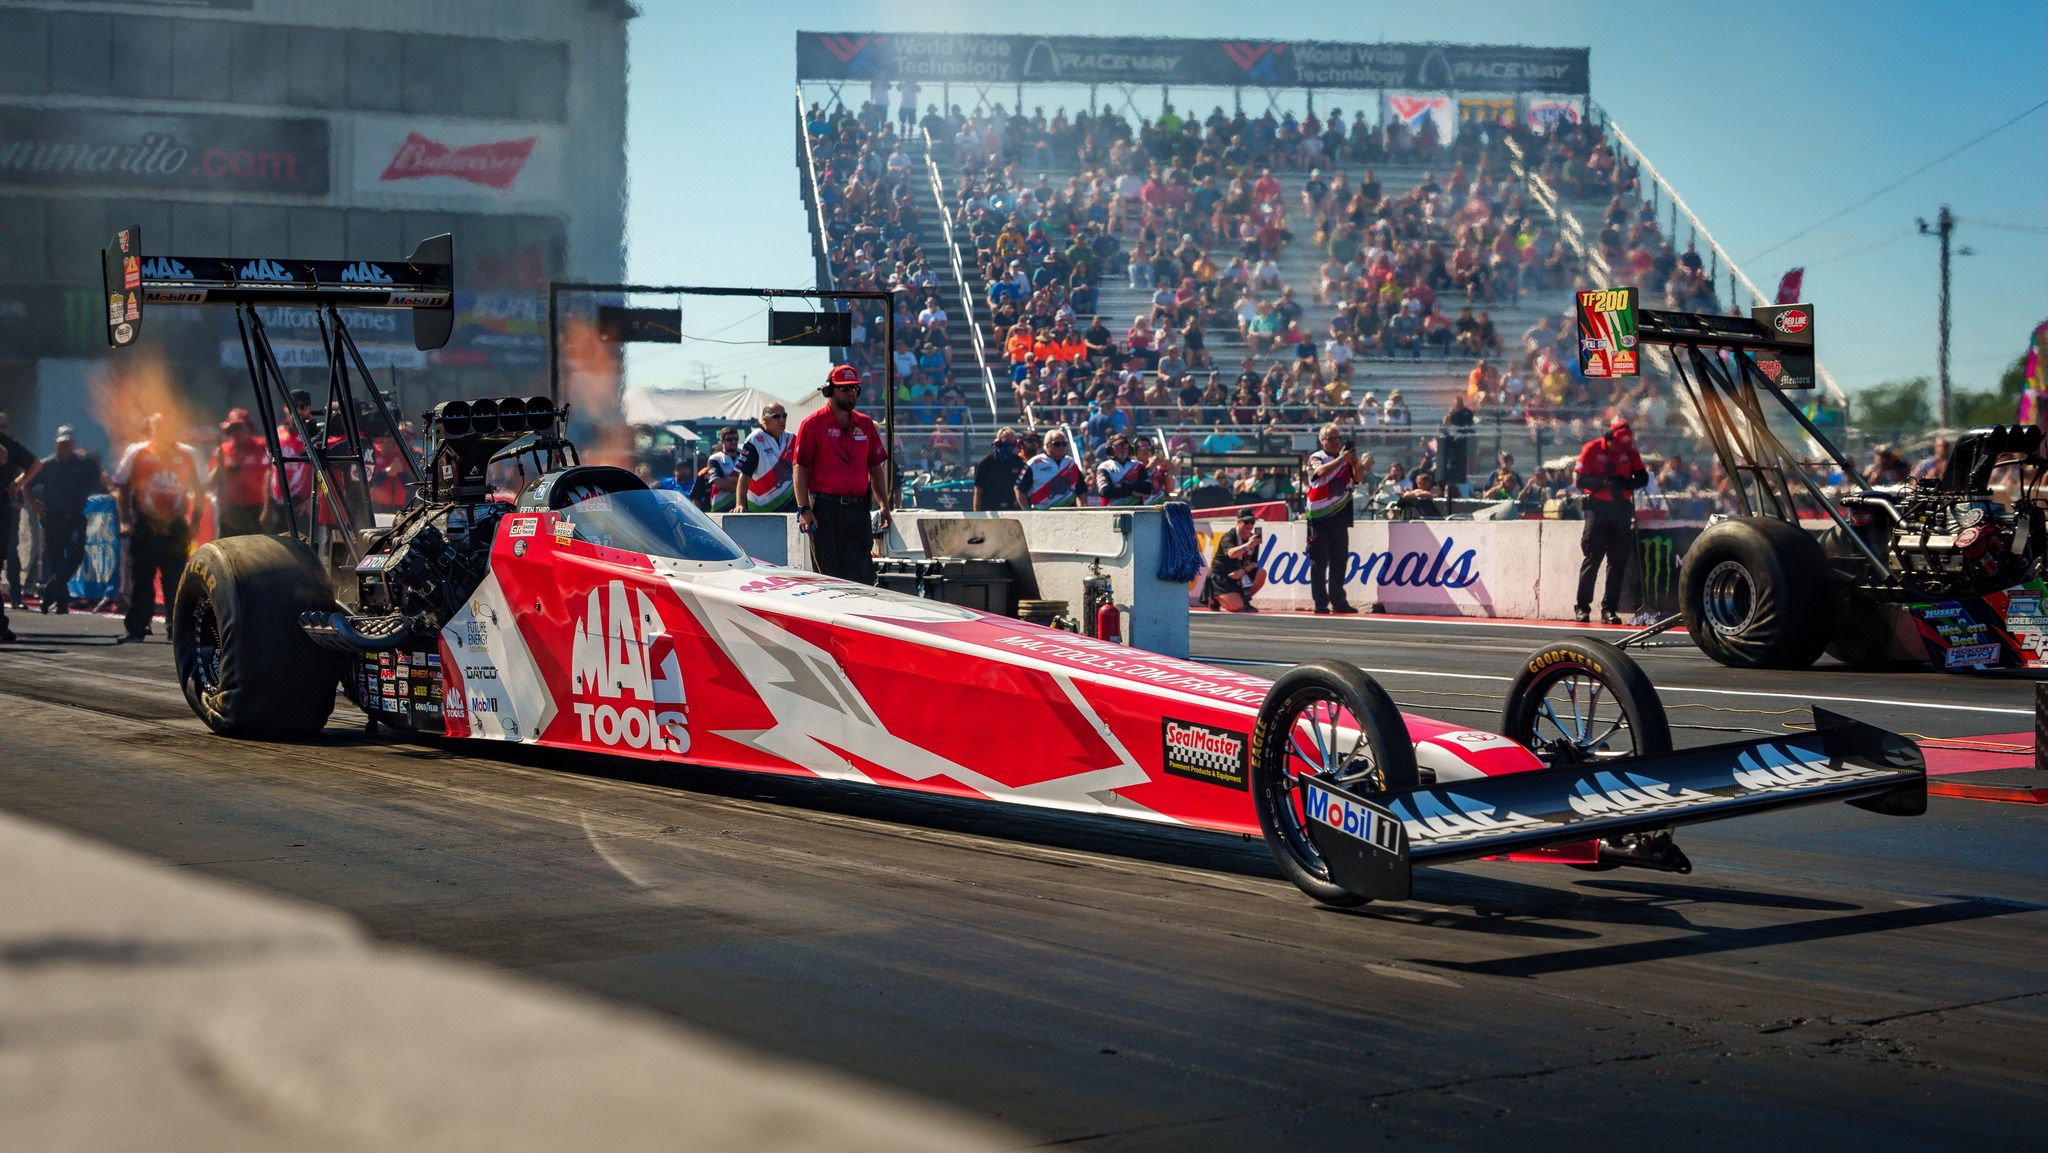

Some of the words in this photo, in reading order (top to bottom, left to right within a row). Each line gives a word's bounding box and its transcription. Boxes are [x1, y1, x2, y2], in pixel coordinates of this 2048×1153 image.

[894, 37, 952, 56] World
[957, 38, 1011, 56] Wide
[1294, 45, 1350, 64] World
[1356, 47, 1405, 65] Wide
[897, 56, 1011, 79] Technology
[1061, 52, 1181, 71] RACEWAY
[1454, 63, 1571, 80] RACEWAY
[1296, 64, 1406, 87] Technology
[141, 256, 195, 279] MAC
[240, 259, 294, 282] MAC
[341, 261, 394, 284] MAC
[146, 293, 186, 302] Mobil
[391, 296, 429, 306] Mobil
[1582, 290, 1629, 313] TF200
[1783, 316, 1795, 325] RED
[1924, 607, 1962, 618] HUSSEY
[467, 621, 488, 634] FUTURE
[468, 633, 488, 645] ENERGY
[469, 645, 490, 653] SOLUTIONS
[571, 579, 687, 704] MAC
[1950, 632, 1980, 647] Beef
[381, 668, 395, 678] ARP
[465, 666, 498, 680] DAYCO
[415, 701, 439, 713] GOODYEAR
[446, 687, 464, 709] MAC
[471, 697, 491, 712] Mobil
[446, 709, 465, 719] TOOLS
[573, 702, 692, 755] TOOLS
[1168, 724, 1240, 757] SealMaster
[1251, 717, 1268, 769] EAGLE
[1168, 760, 1191, 772] Pavement
[1191, 765, 1212, 777] Products
[1216, 772, 1242, 784] Equipment
[1733, 743, 1878, 790] MAC
[1568, 771, 1715, 818] MAC
[1306, 785, 1372, 842] Mobil
[1388, 790, 1545, 839] MAC
